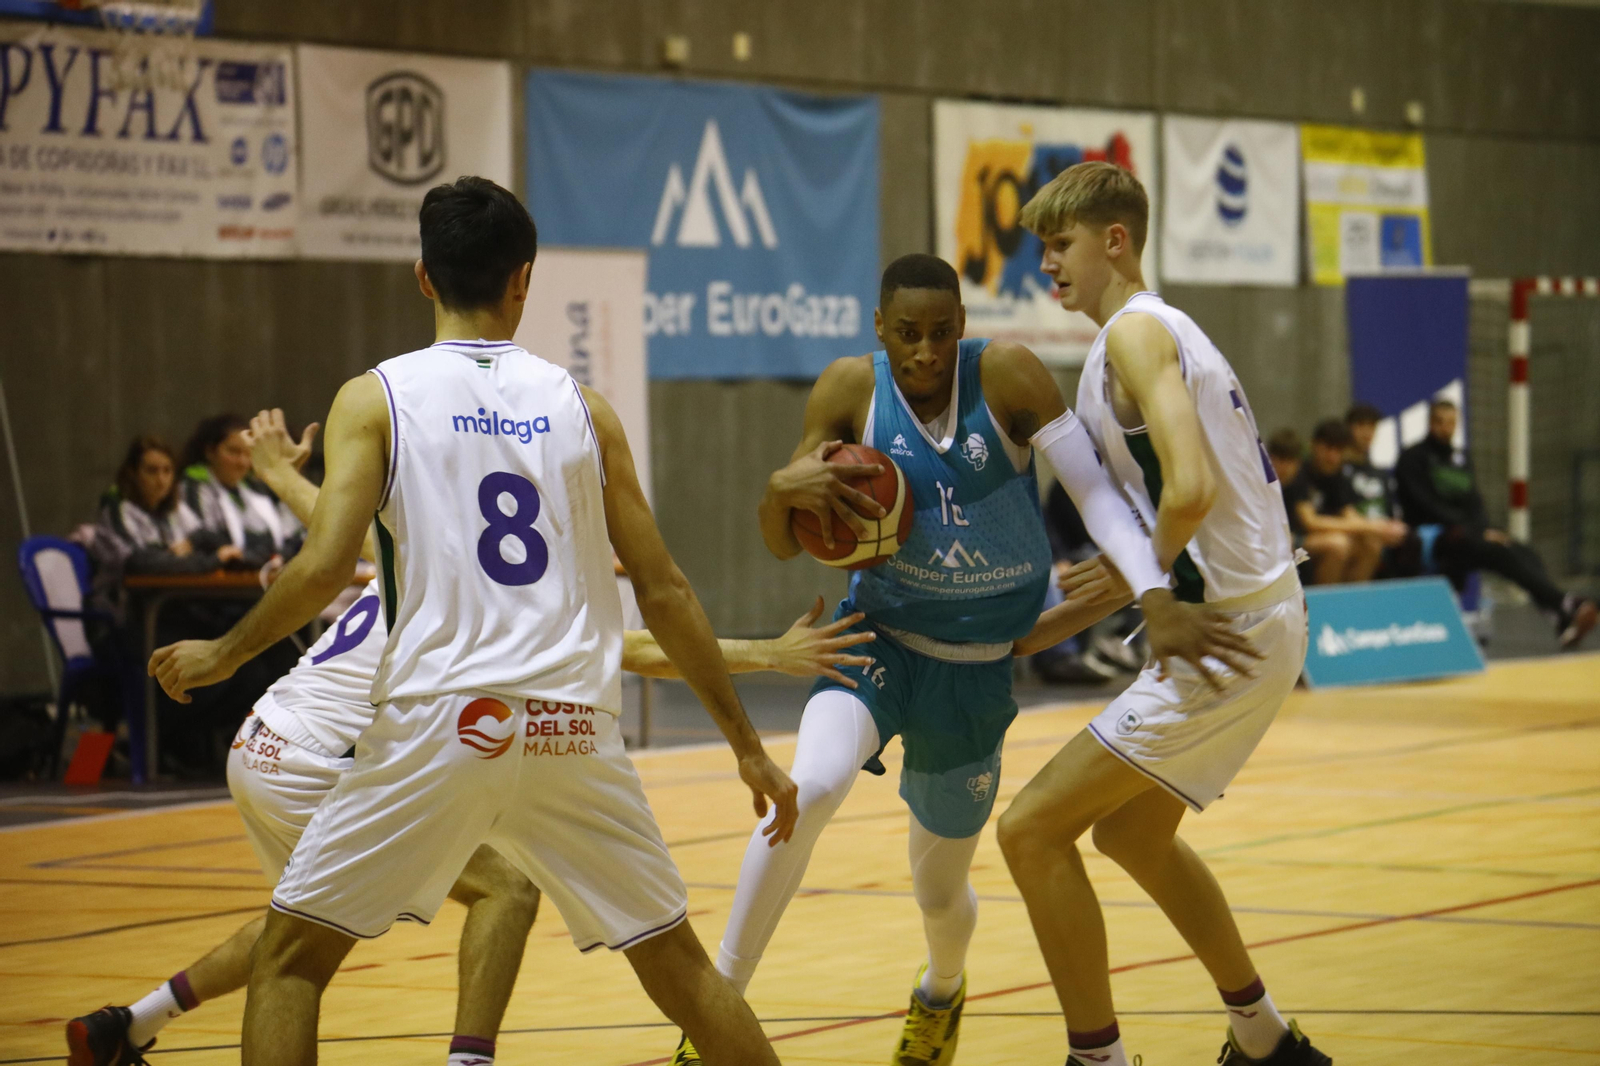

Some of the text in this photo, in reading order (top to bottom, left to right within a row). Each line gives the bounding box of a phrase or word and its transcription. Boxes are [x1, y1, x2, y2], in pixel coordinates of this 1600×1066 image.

[706, 281, 861, 337] EuroGaza
[477, 471, 549, 586] 8
[886, 555, 1033, 584] Camper EuroGaza
[900, 576, 1016, 594] www.campereurogaza.com
[312, 594, 381, 666] 9
[525, 698, 596, 717] COSTA
[525, 719, 597, 738] DEL SOL
[257, 742, 282, 761] SOL
[523, 737, 599, 757] MÁLAGA
